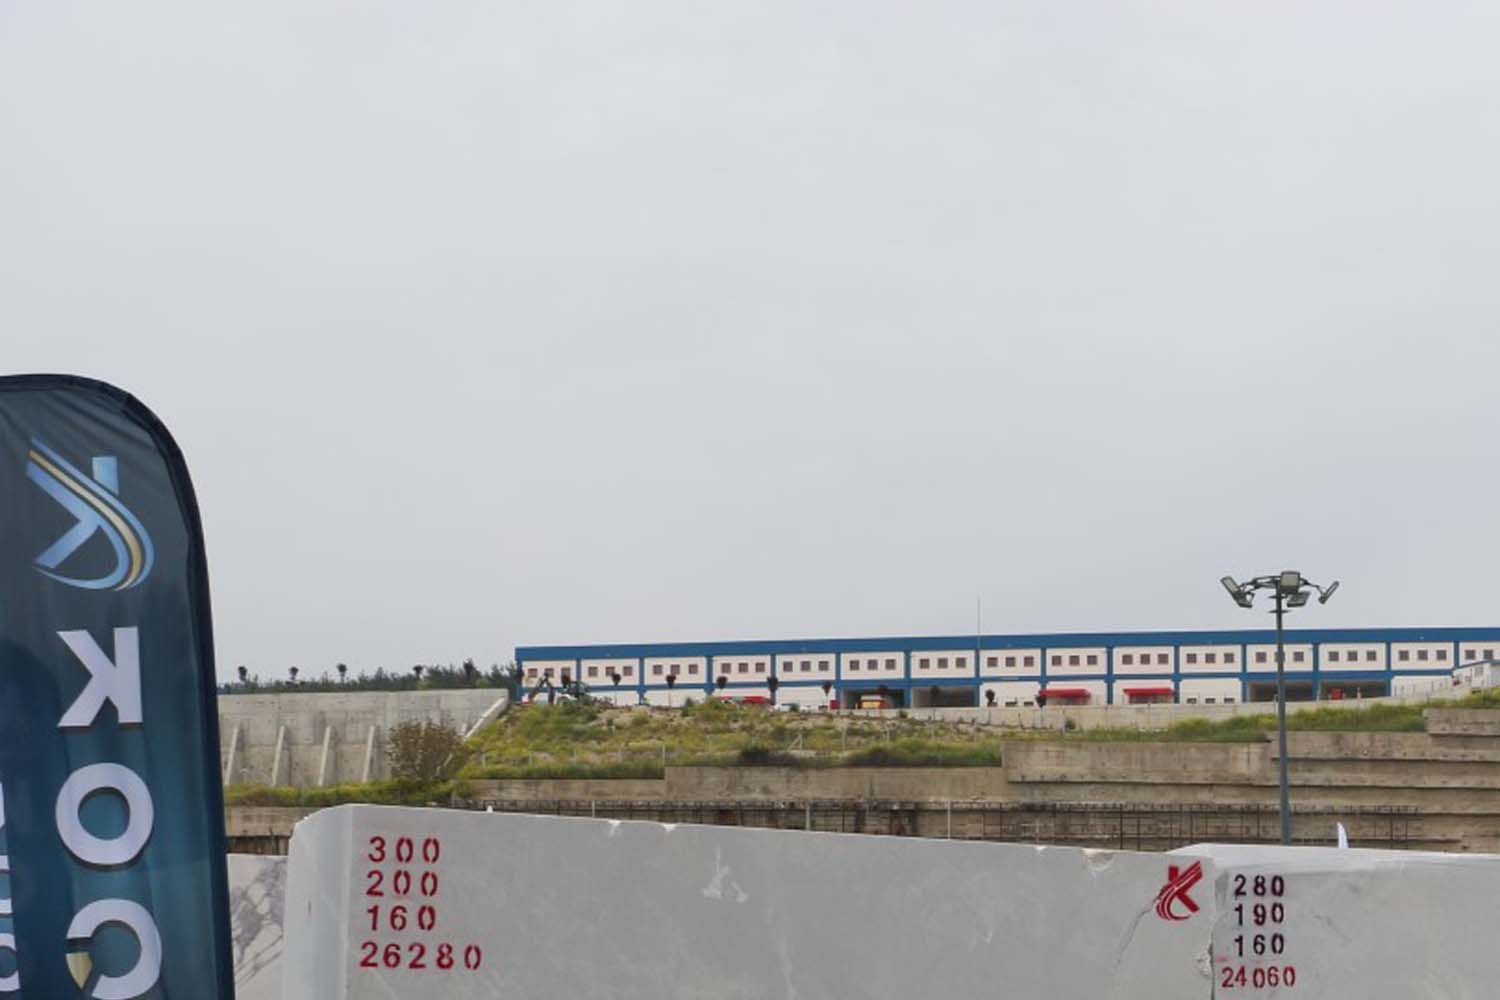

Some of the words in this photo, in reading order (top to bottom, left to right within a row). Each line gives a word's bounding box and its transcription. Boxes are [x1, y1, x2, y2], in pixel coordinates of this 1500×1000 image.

[368, 836, 440, 863] 300
[366, 870, 438, 896] 200
[1234, 874, 1284, 897] 280
[367, 905, 436, 931] 160
[1234, 902, 1284, 926] 190
[360, 941, 482, 970] 26280
[1234, 933, 1284, 957] 160
[1222, 965, 1296, 988] 24060
